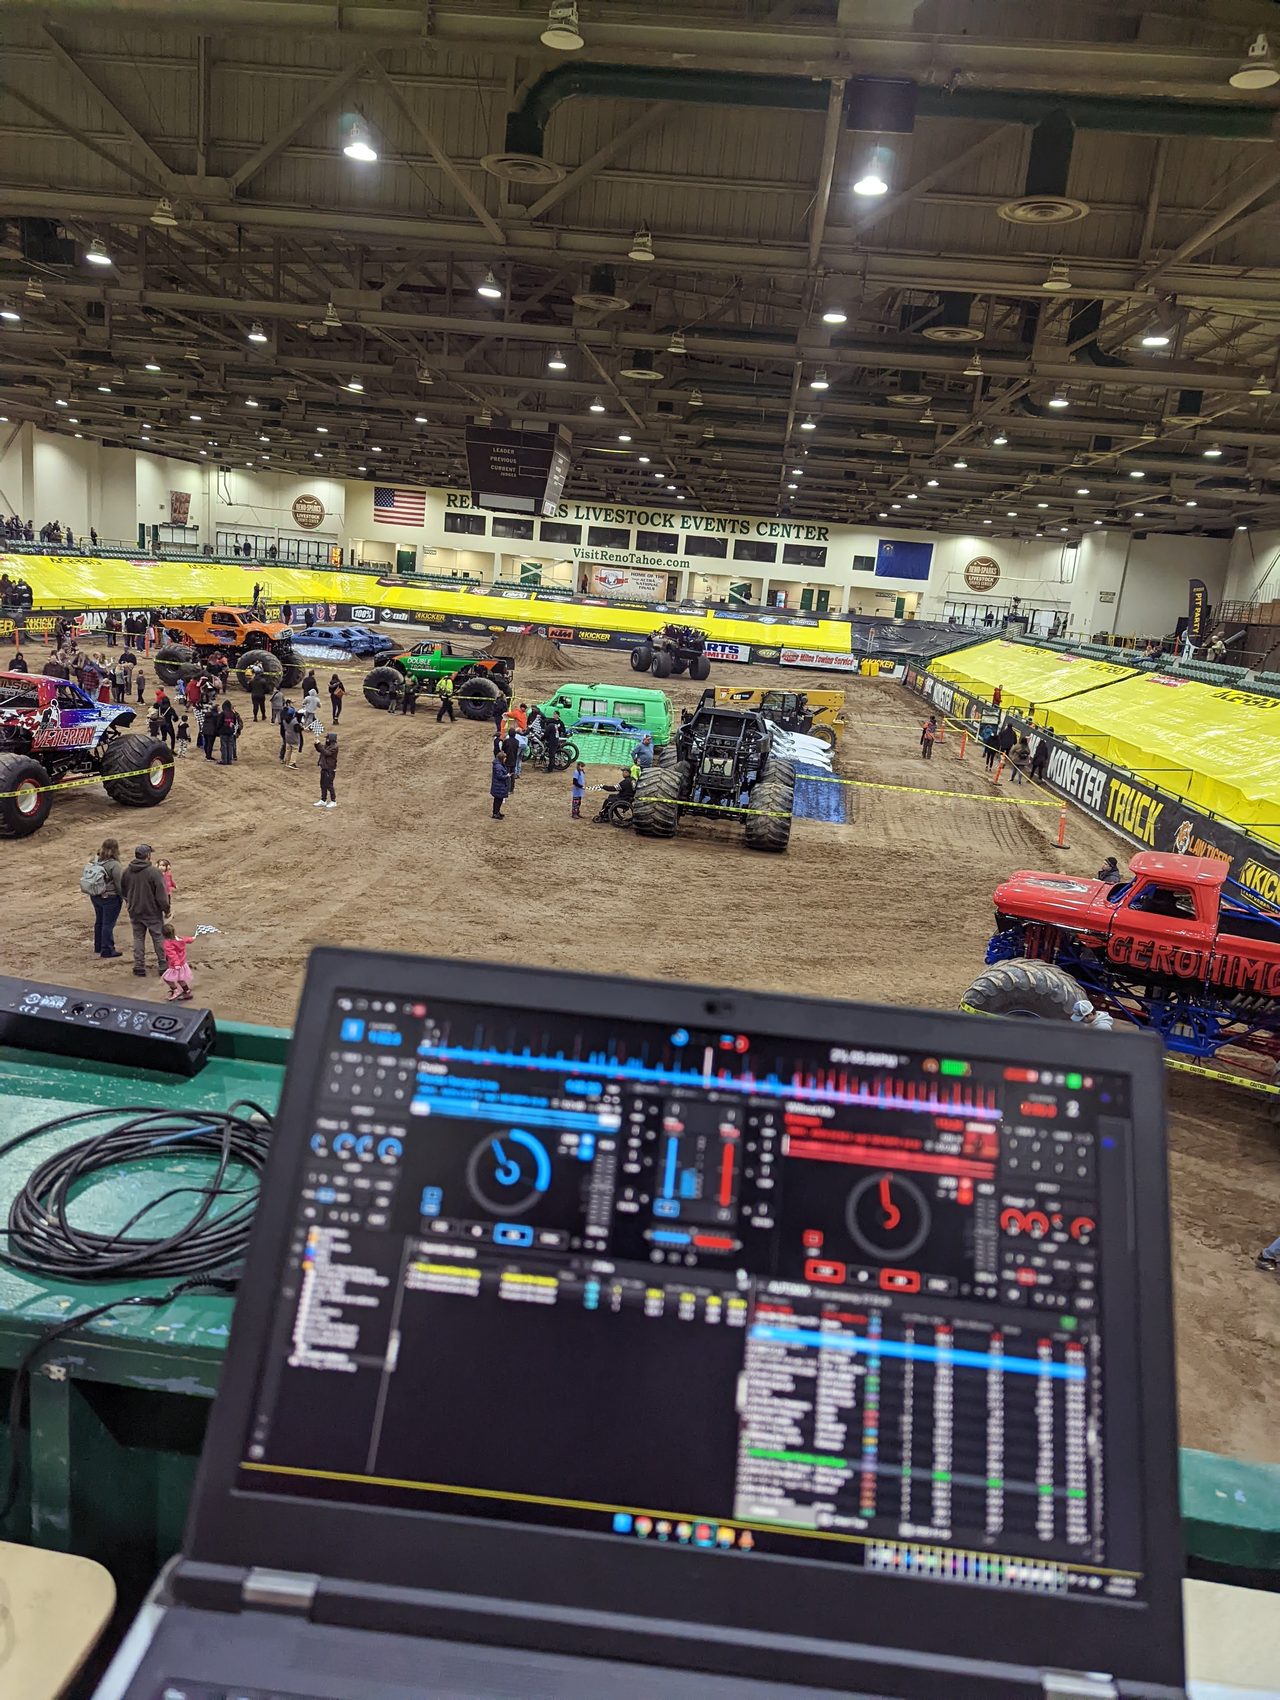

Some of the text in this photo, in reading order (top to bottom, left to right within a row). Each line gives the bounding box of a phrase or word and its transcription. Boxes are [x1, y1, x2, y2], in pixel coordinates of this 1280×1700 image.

[490, 464, 516, 472] CURRENT
[574, 505, 675, 528] LIVESTOCK
[680, 514, 751, 535] EVENTS
[755, 521, 829, 542] CENTER
[573, 547, 690, 568] VisitRenoTahoe.com
[354, 609, 372, 618] 100%
[420, 613, 446, 622] KICKER
[1192, 607, 1202, 634] PARTY
[550, 630, 572, 638] KTM
[584, 632, 610, 641] KICKER
[407, 658, 432, 666] DOUBLE
[815, 654, 833, 664] Towing
[833, 656, 854, 666] Service
[32, 726, 96, 748] VETERAN
[1047, 746, 1164, 847] MONSTER TRUCK
[1188, 835, 1205, 858] LAW
[1190, 1066, 1267, 1090] CAUTION CUIDADO CAUTION
